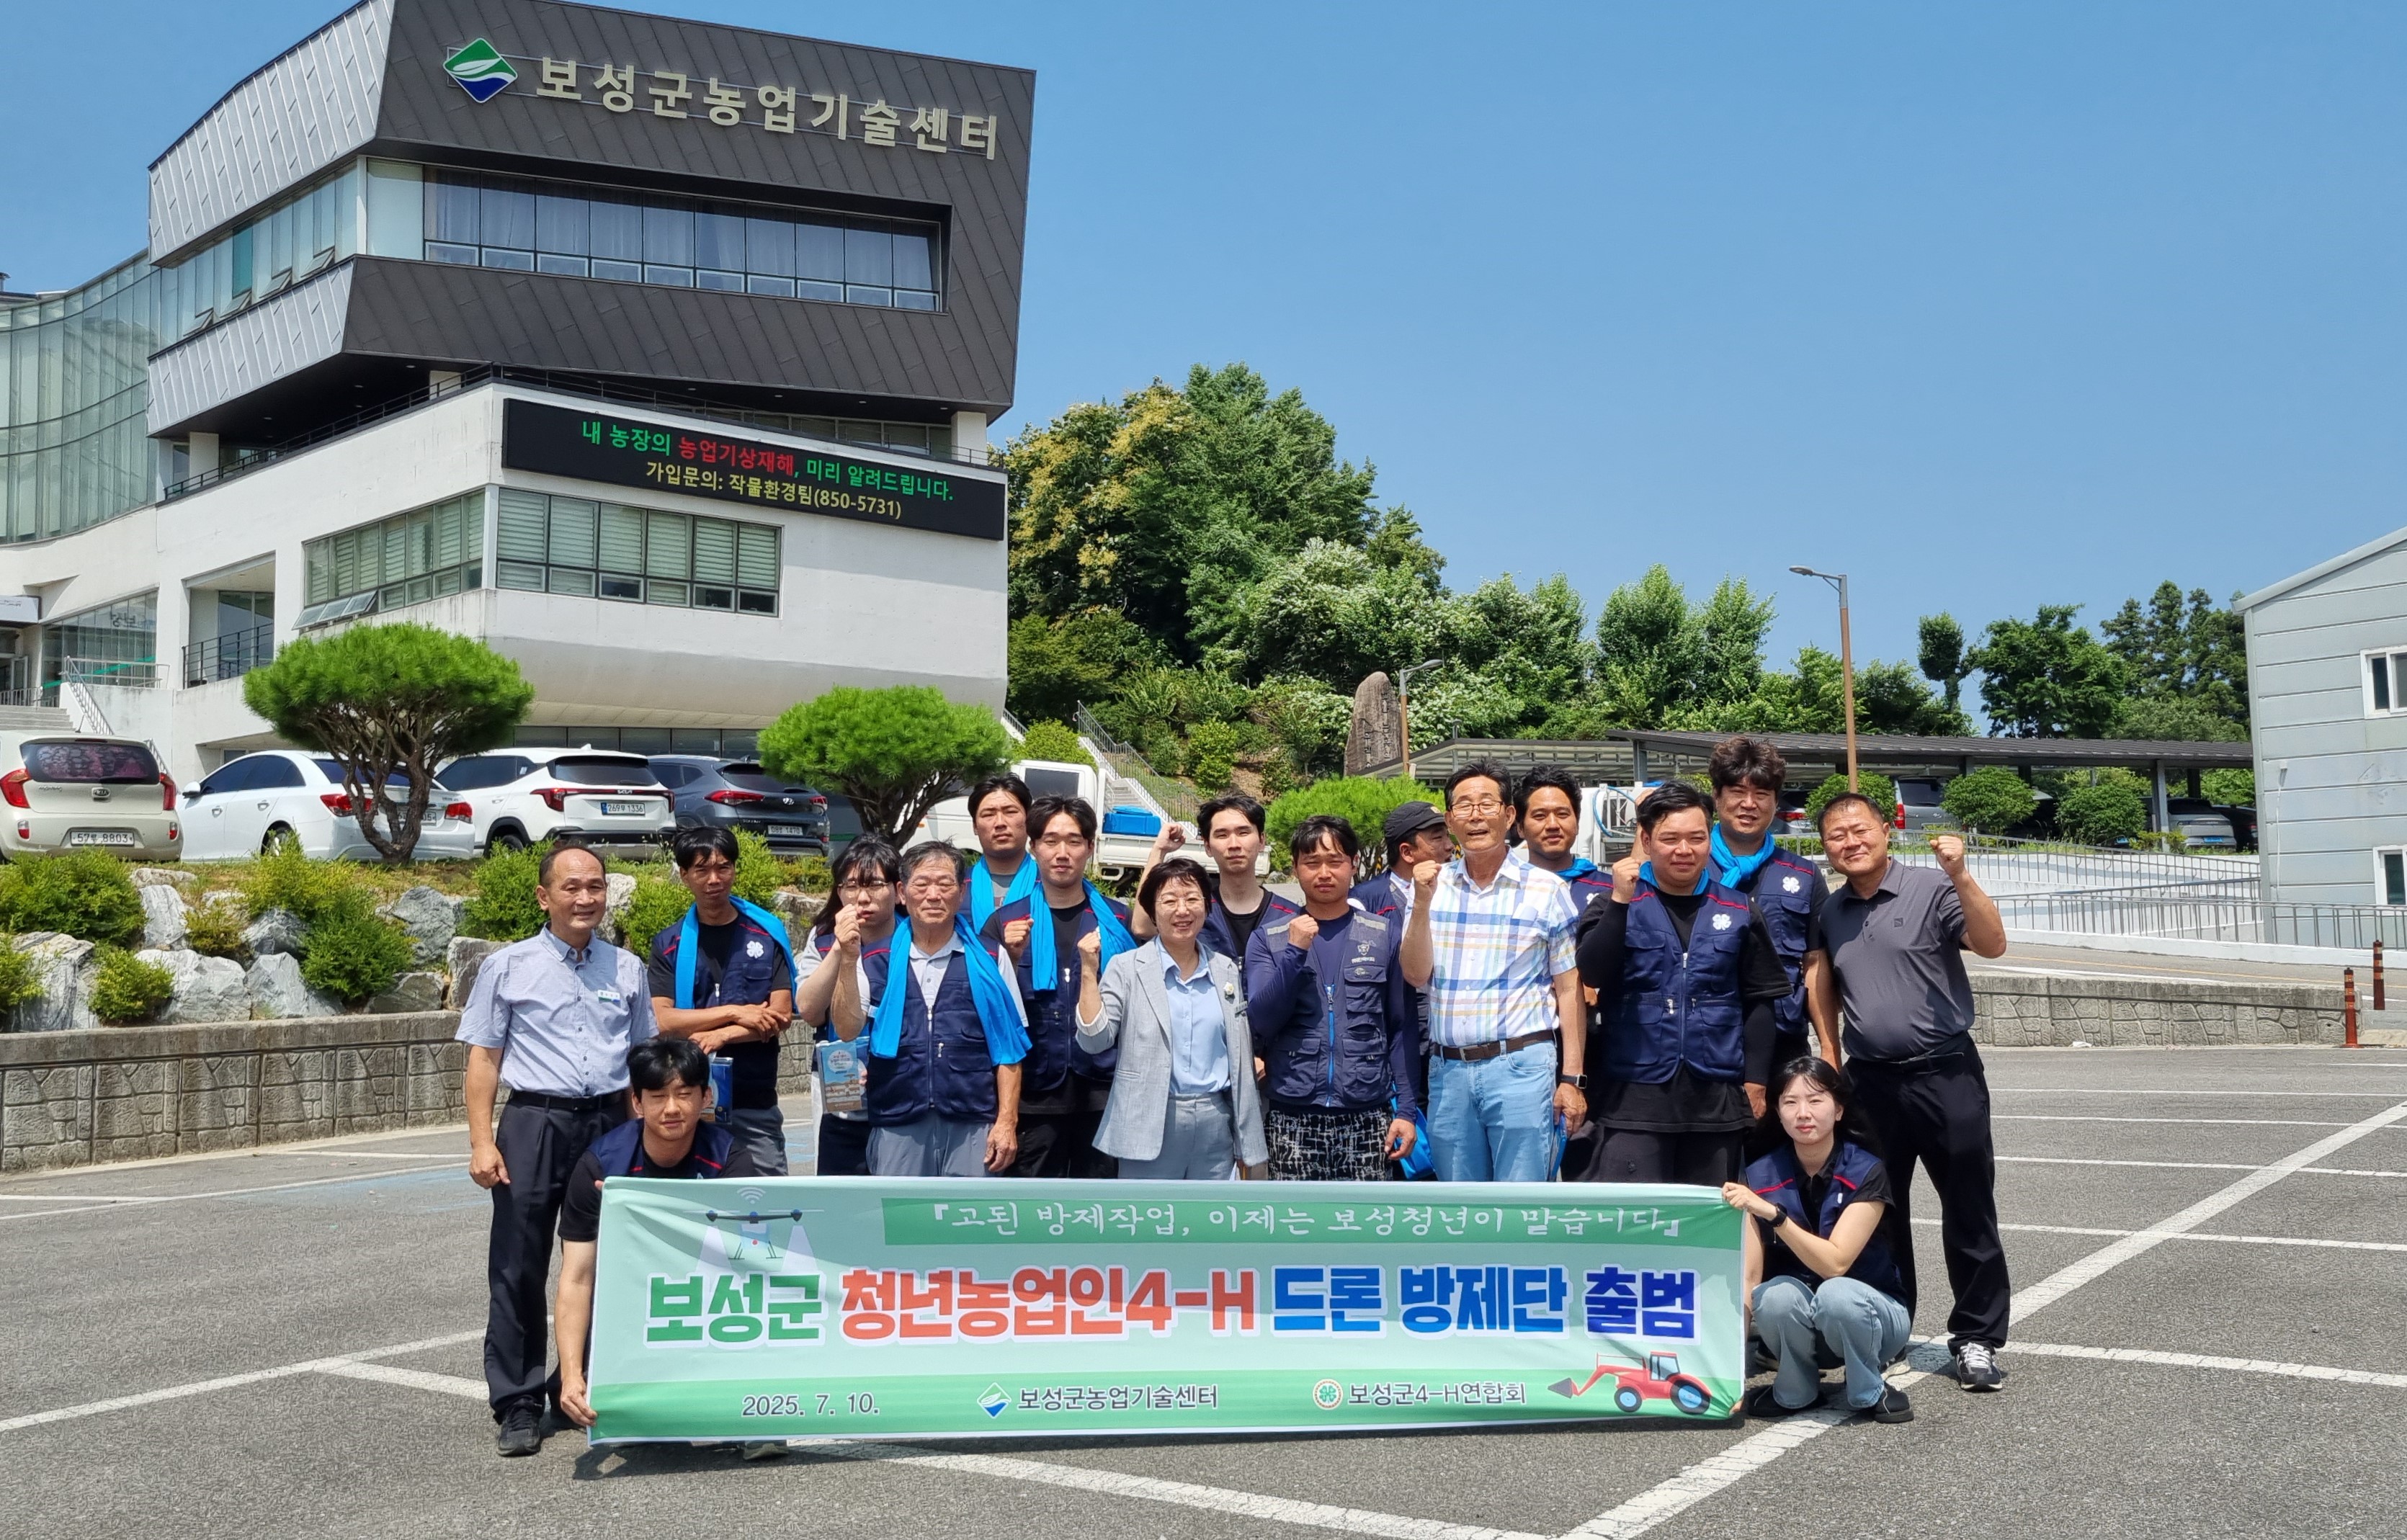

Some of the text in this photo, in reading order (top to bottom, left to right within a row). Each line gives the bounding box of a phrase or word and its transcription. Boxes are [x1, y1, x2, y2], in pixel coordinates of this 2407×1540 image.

[536, 57, 997, 161] 보성군농업기술센터
[583, 421, 954, 501] 내 농장의 농업기상재해, 미리 알려드립니다.
[646, 462, 902, 519] 가입문의: 작물환경팀(850-5731)
[102, 833, 129, 843] 8803
[1036, 1202, 1190, 1236] 방제작업,
[1210, 1205, 1316, 1235] 이제는
[1327, 1206, 1504, 1236] 보성청년이
[647, 1266, 1695, 1343] 보성군 청년농업인4-H 드론 방제단 출범
[742, 1394, 878, 1416] 2025. 7. 10.
[1019, 1385, 1218, 1410] 보성군농업기술센터
[1349, 1383, 1526, 1405] 보성군4-H연합회
